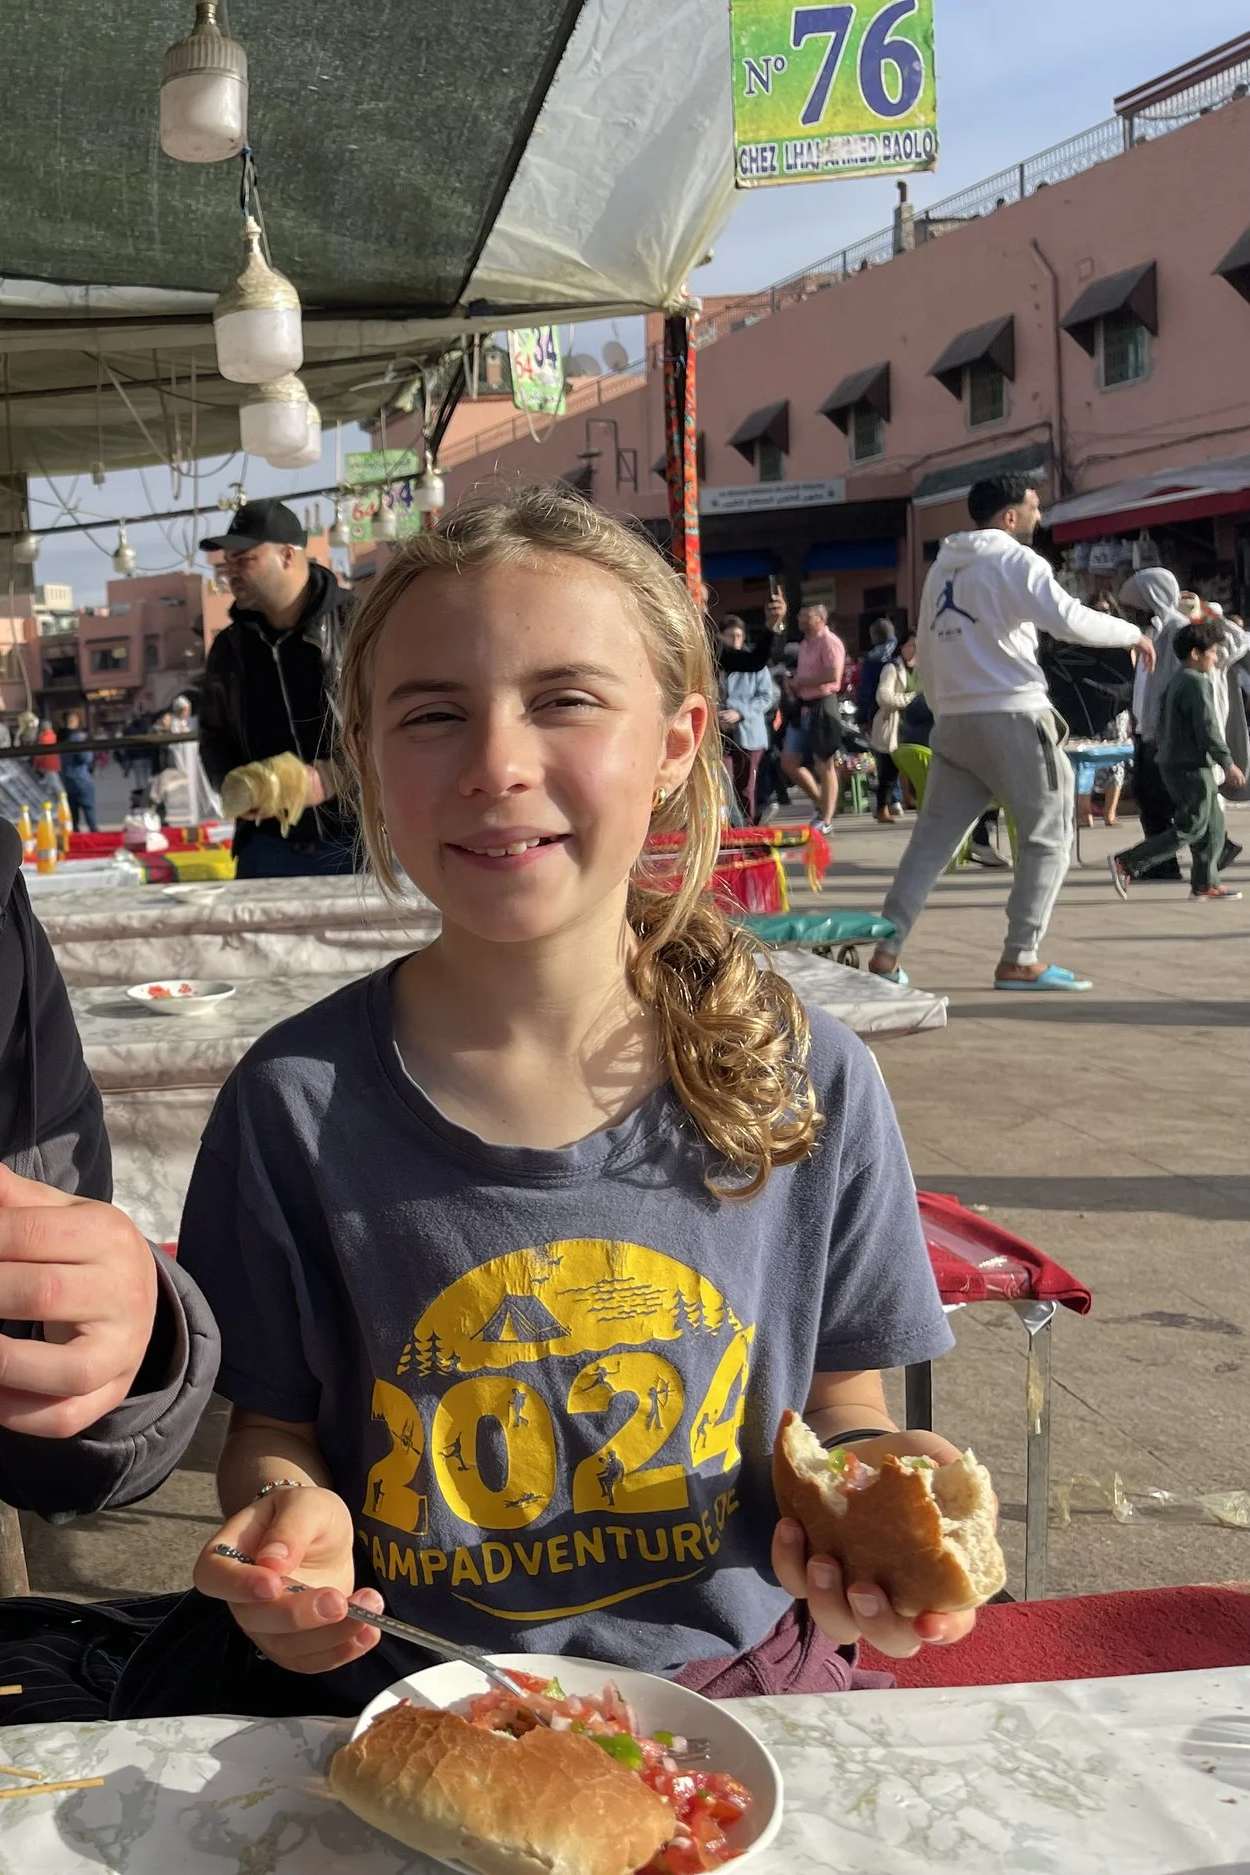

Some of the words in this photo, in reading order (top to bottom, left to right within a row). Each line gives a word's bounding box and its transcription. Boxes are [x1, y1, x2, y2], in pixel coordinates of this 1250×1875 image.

[791, 0, 924, 125] 76
[738, 145, 778, 175] CHEZ
[881, 130, 933, 162] BAOLO
[361, 1324, 756, 1537] 2024
